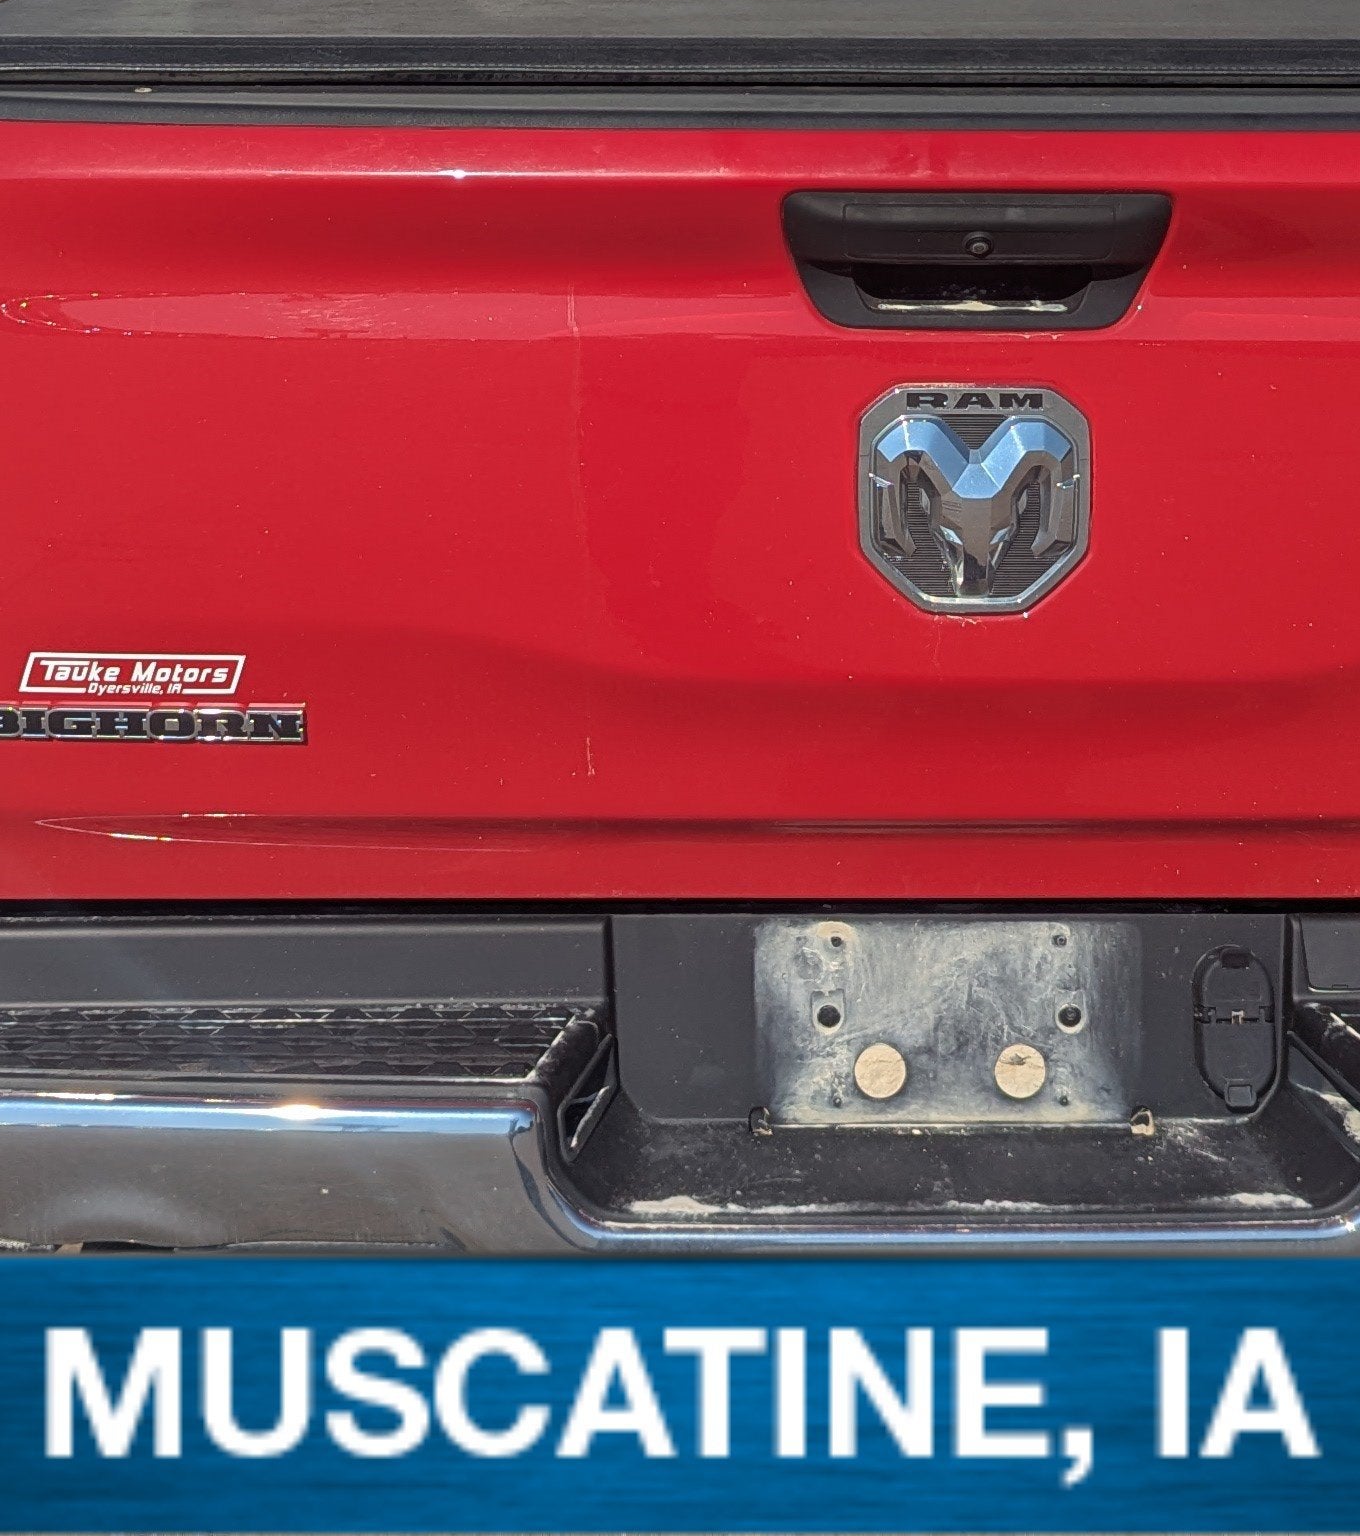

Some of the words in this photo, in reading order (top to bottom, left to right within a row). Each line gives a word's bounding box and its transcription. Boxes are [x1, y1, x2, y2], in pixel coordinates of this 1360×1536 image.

[905, 392, 1044, 410] RAM
[40, 660, 121, 682] Tauke
[131, 661, 230, 683] Motors
